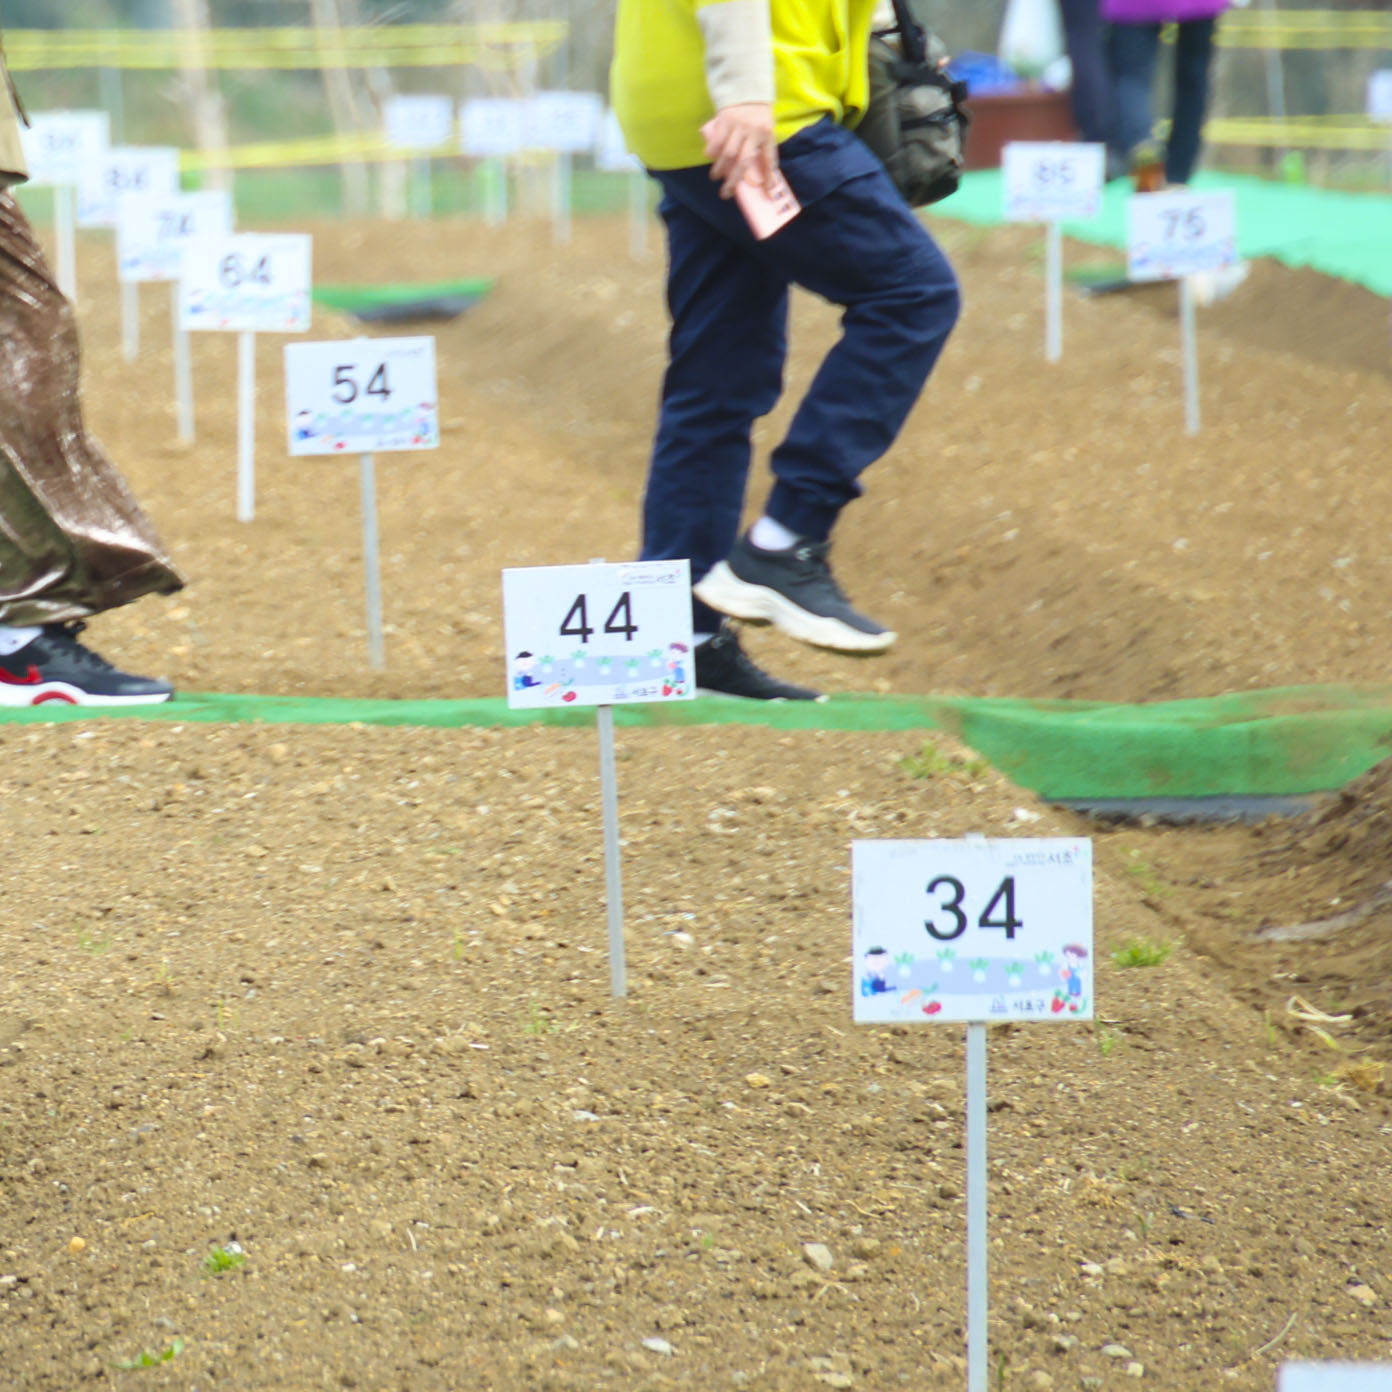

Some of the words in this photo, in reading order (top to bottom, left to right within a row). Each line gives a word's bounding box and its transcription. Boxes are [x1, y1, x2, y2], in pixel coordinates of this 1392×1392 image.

[1160, 208, 1205, 240] 75
[219, 252, 272, 290] 64
[333, 362, 392, 405] 54
[559, 592, 638, 643] 44
[924, 875, 1023, 940] 34
